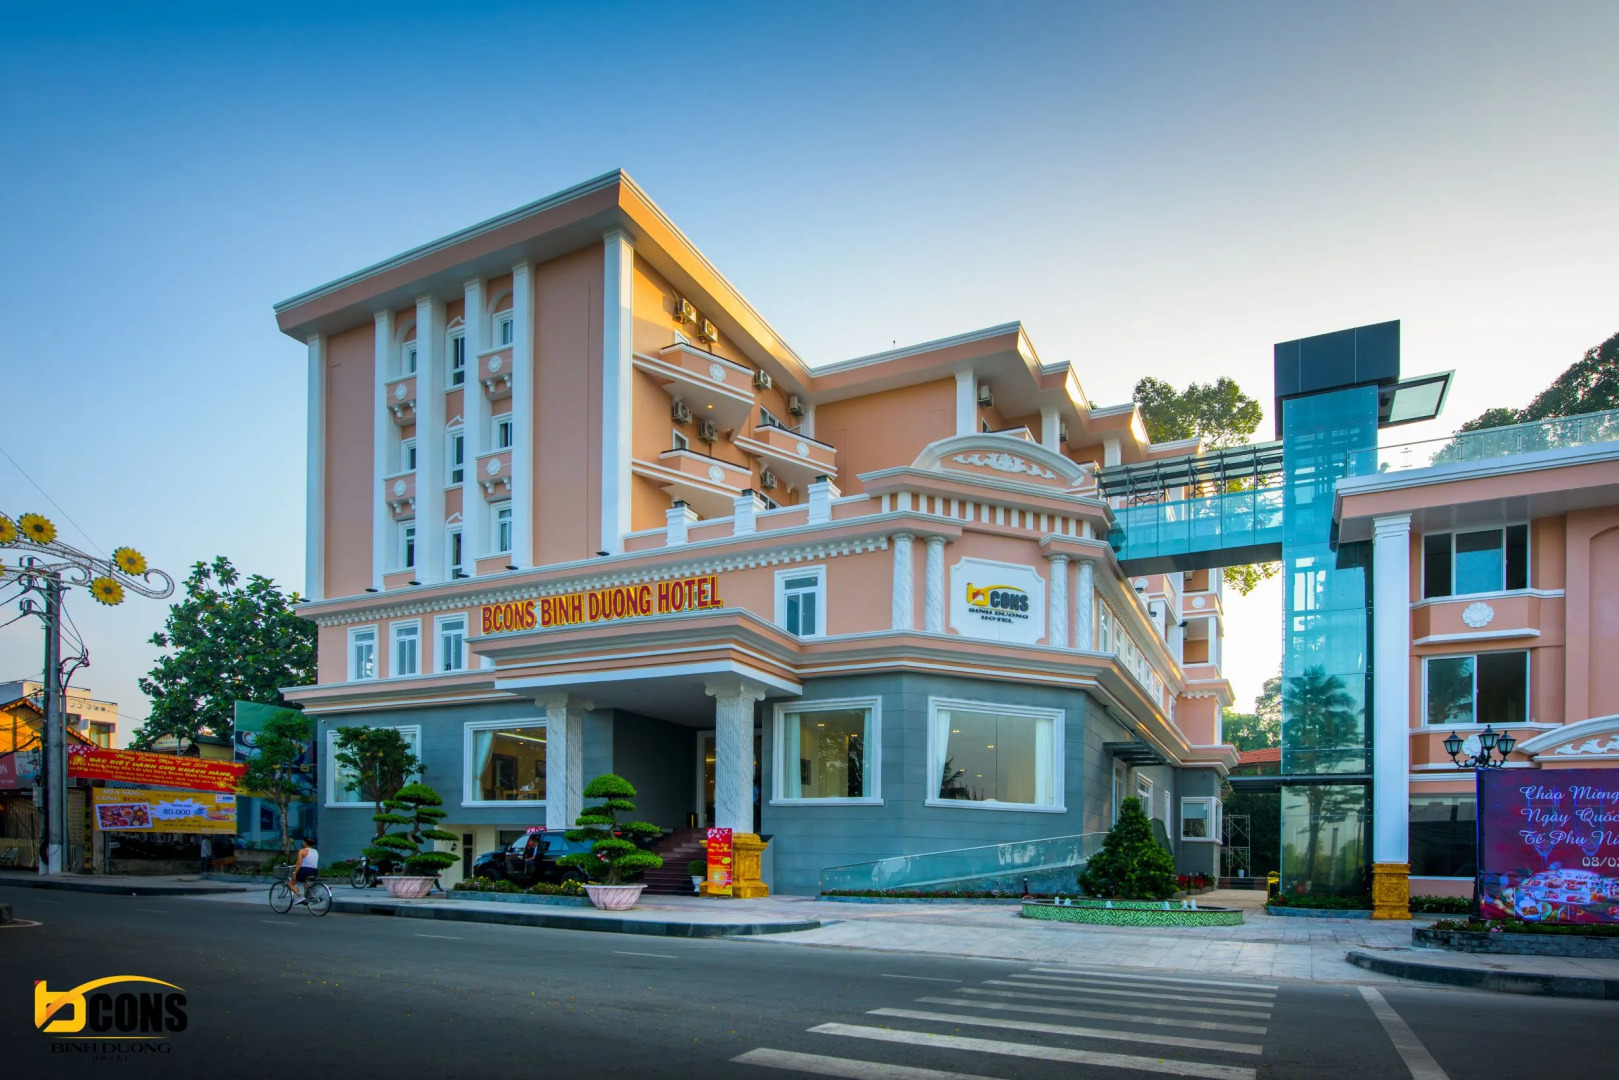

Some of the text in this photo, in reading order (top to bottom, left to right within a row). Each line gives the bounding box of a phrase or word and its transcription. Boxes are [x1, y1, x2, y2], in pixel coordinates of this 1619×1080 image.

[482, 575, 724, 634] BCONS BINH DUONG HOTEL
[968, 607, 993, 616] BINH
[981, 615, 1014, 623] HOTEL
[1519, 785, 1566, 800] Chào
[163, 808, 191, 816] 80.000
[1520, 807, 1619, 828] Ngày Quốc
[1549, 830, 1587, 847] Phụ
